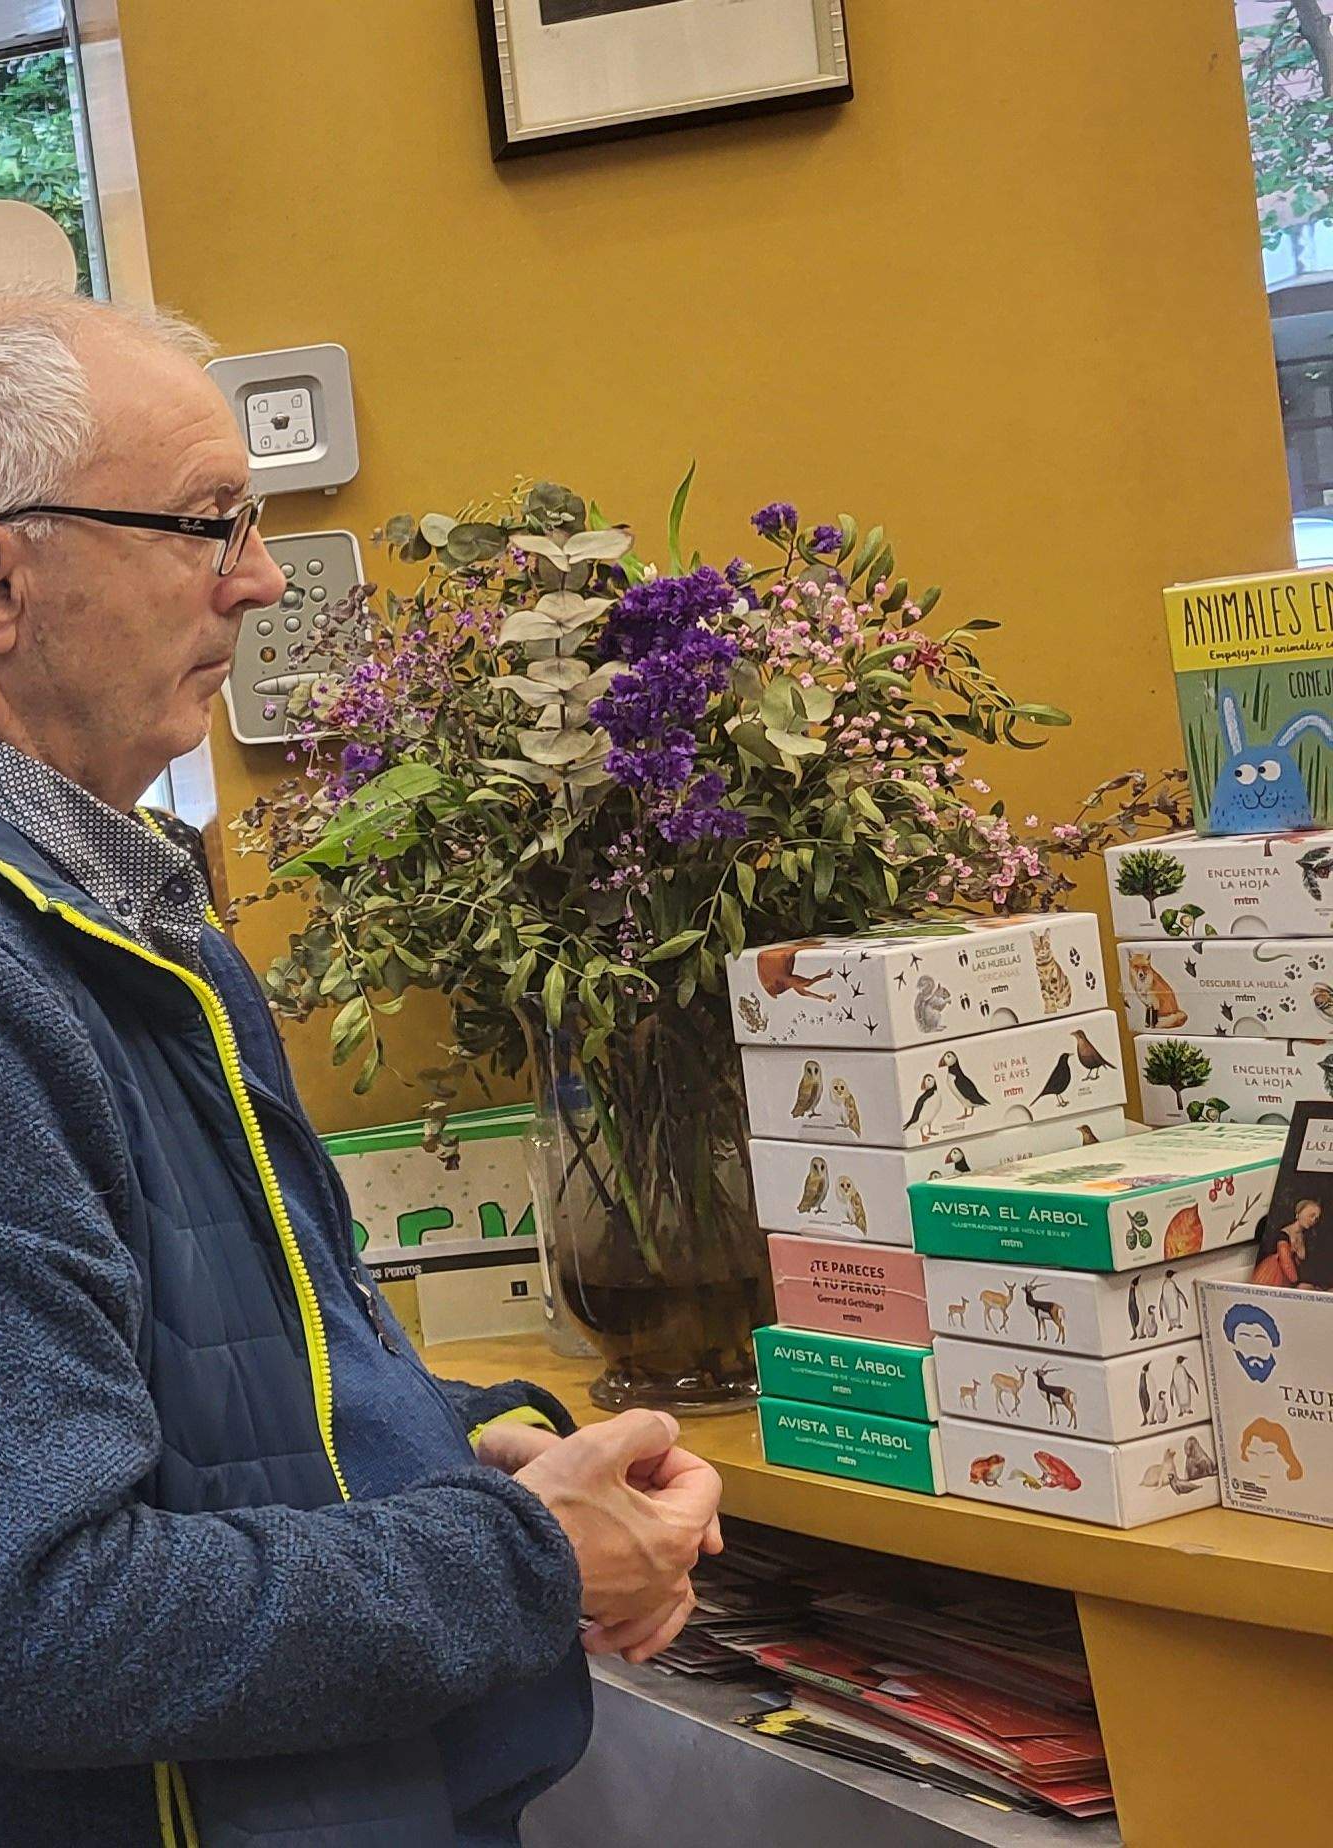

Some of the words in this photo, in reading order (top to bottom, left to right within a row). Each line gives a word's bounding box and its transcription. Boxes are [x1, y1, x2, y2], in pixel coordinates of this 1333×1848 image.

[1183, 585, 1302, 647] ANIMALES
[1207, 867, 1281, 879] ENCUENTRA
[1220, 880, 1234, 890] LA
[1239, 879, 1270, 891] HOJA
[1234, 896, 1259, 906] mtm
[975, 943, 1016, 958] DESCUBRE
[972, 961, 987, 972] LAS
[987, 954, 1022, 968] HUELLAS
[1199, 979, 1242, 988] DESCUBRE
[1244, 980, 1254, 988] LA
[1256, 980, 1289, 989] HUELLA
[1235, 994, 1257, 1002] mtm
[992, 1060, 1008, 1071] UN
[1011, 1056, 1029, 1067] PAR
[1233, 1064, 1303, 1076] ENCUENTRA
[994, 1073, 1006, 1083] DE
[1009, 1069, 1031, 1080] AVES
[1245, 1078, 1259, 1087] LA
[1263, 1078, 1293, 1089] HOJA
[1258, 1094, 1283, 1104] mtm
[931, 1201, 991, 1218] AVISTA
[999, 1206, 1021, 1220] EL
[1028, 1206, 1089, 1226] ÁRBOL
[1000, 1239, 1023, 1248] mtm
[810, 1259, 830, 1273] ¿TE
[831, 1261, 885, 1279] PARECES
[812, 1276, 821, 1288] A
[822, 1277, 839, 1290] TU
[773, 1346, 824, 1365] AVISTA
[830, 1355, 849, 1369] EL
[855, 1356, 906, 1378] ÁRBOL
[778, 1415, 829, 1435] AVISTA
[836, 1426, 854, 1440] EL
[861, 1428, 912, 1451] ÁRBOL
